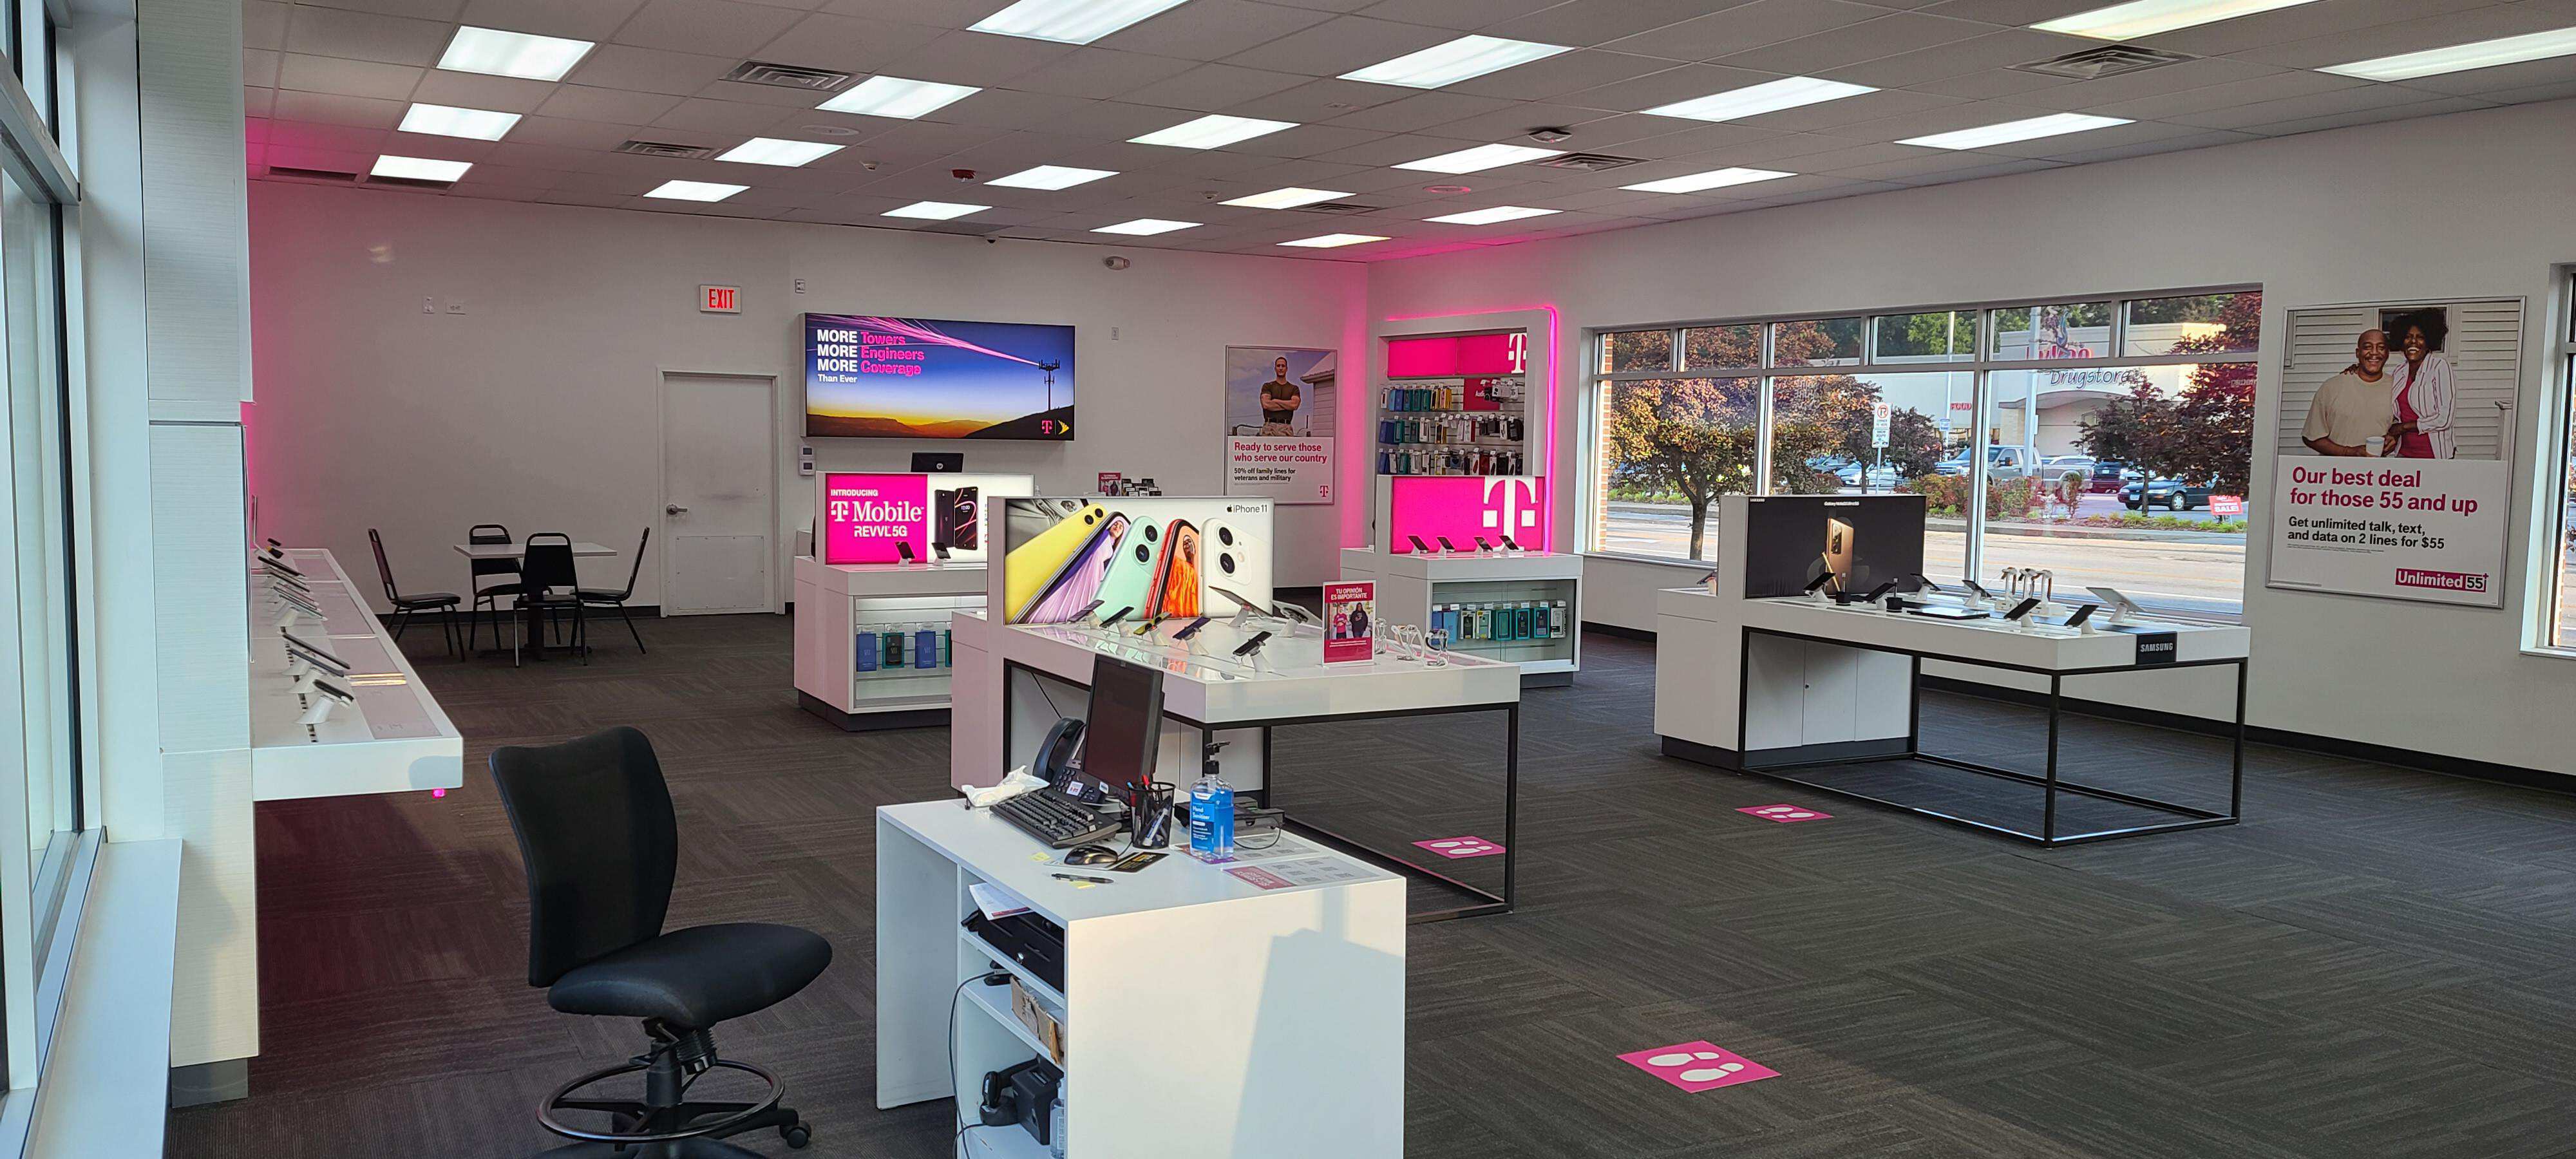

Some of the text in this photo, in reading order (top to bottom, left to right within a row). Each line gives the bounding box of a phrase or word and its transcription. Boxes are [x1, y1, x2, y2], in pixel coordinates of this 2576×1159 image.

[708, 288, 734, 309] EXIT
[817, 329, 906, 346] MORE Towers
[817, 344, 925, 361] MORE Engineers
[1508, 333, 1527, 373] T
[817, 358, 922, 377] MORE Coverage
[817, 373, 858, 383] Than Ever
[2050, 367, 2131, 389] Drugstore
[1234, 442, 1261, 453] Ready
[1298, 443, 1322, 451] those
[1234, 453, 1253, 462] who
[1294, 454, 1327, 464] country
[2293, 466, 2421, 487] Our best deal
[1233, 504, 1267, 513] iPhone 11
[2289, 487, 2478, 516] for those 55 and up
[851, 501, 922, 522] Mobile
[1482, 476, 1537, 552] T
[853, 525, 907, 538] REVVL 5G
[2288, 516, 2426, 536] Get unlimited talk, text,
[2287, 530, 2445, 549] and data on 2 lines for $55
[2398, 570, 2463, 588] Unlimited
[2140, 643, 2174, 652] SAMSUNG
